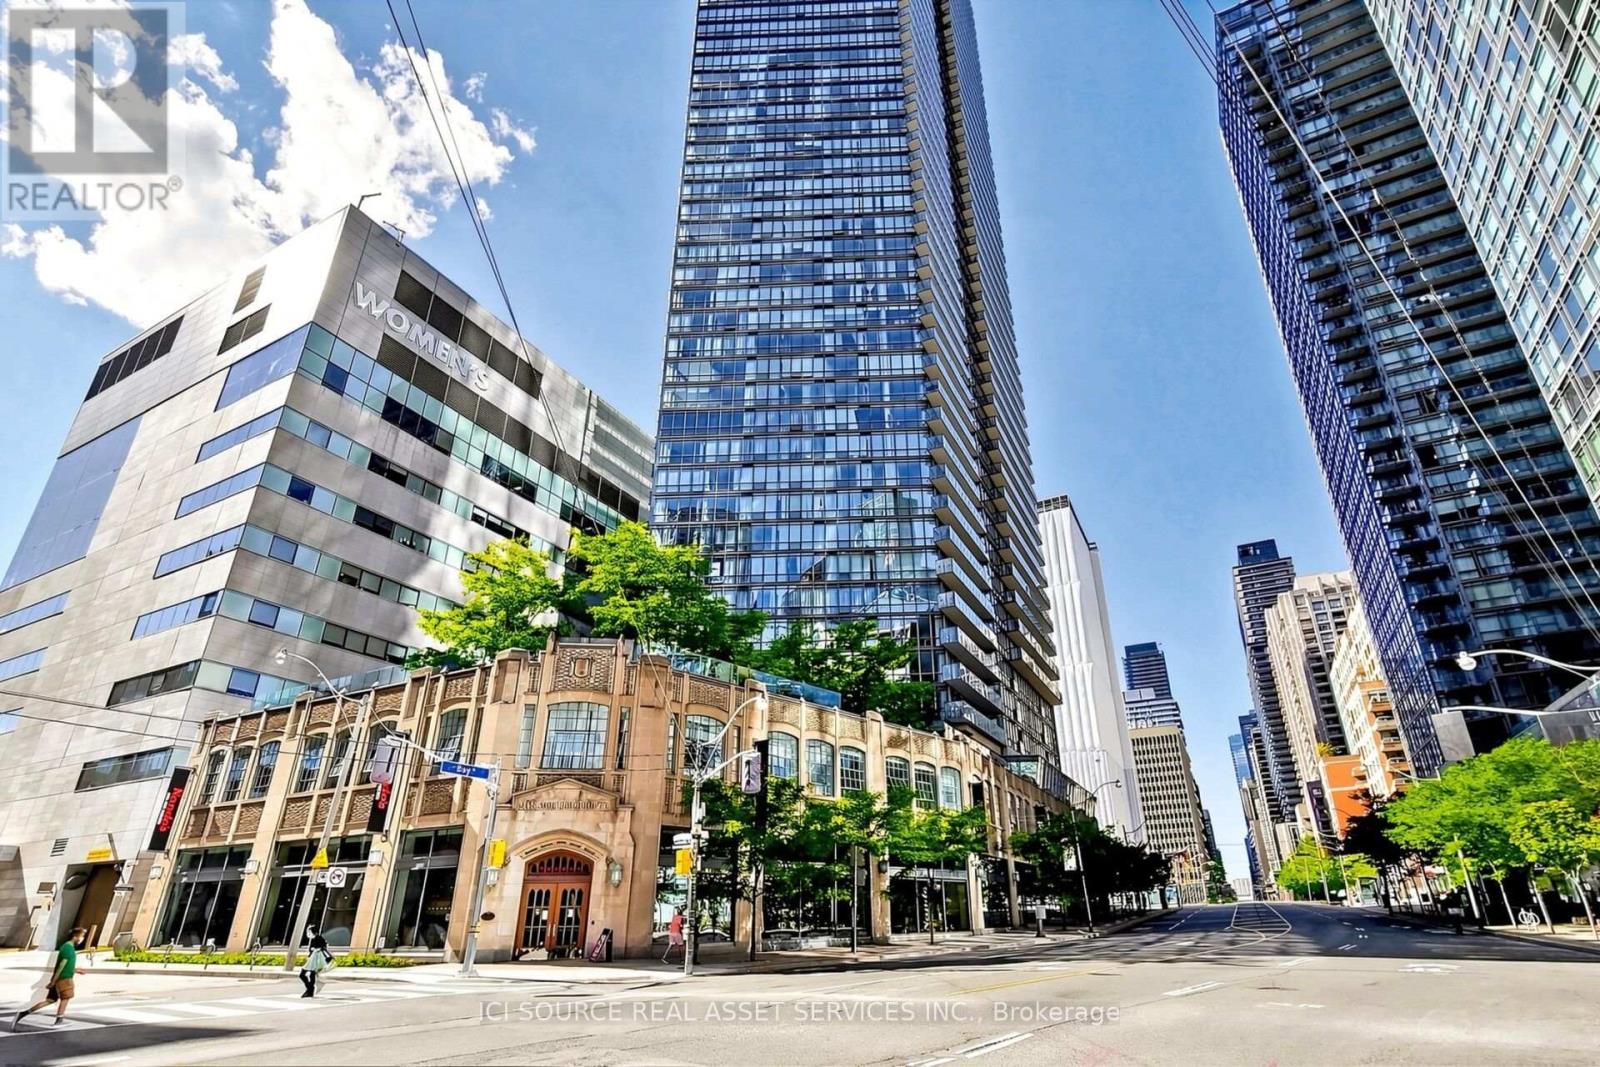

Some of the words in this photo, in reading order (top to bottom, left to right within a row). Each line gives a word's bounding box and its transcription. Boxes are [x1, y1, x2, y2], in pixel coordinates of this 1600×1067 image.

[355, 281, 489, 391] WOMEN'S
[456, 764, 471, 777] Bay
[159, 787, 183, 832] Nando's
